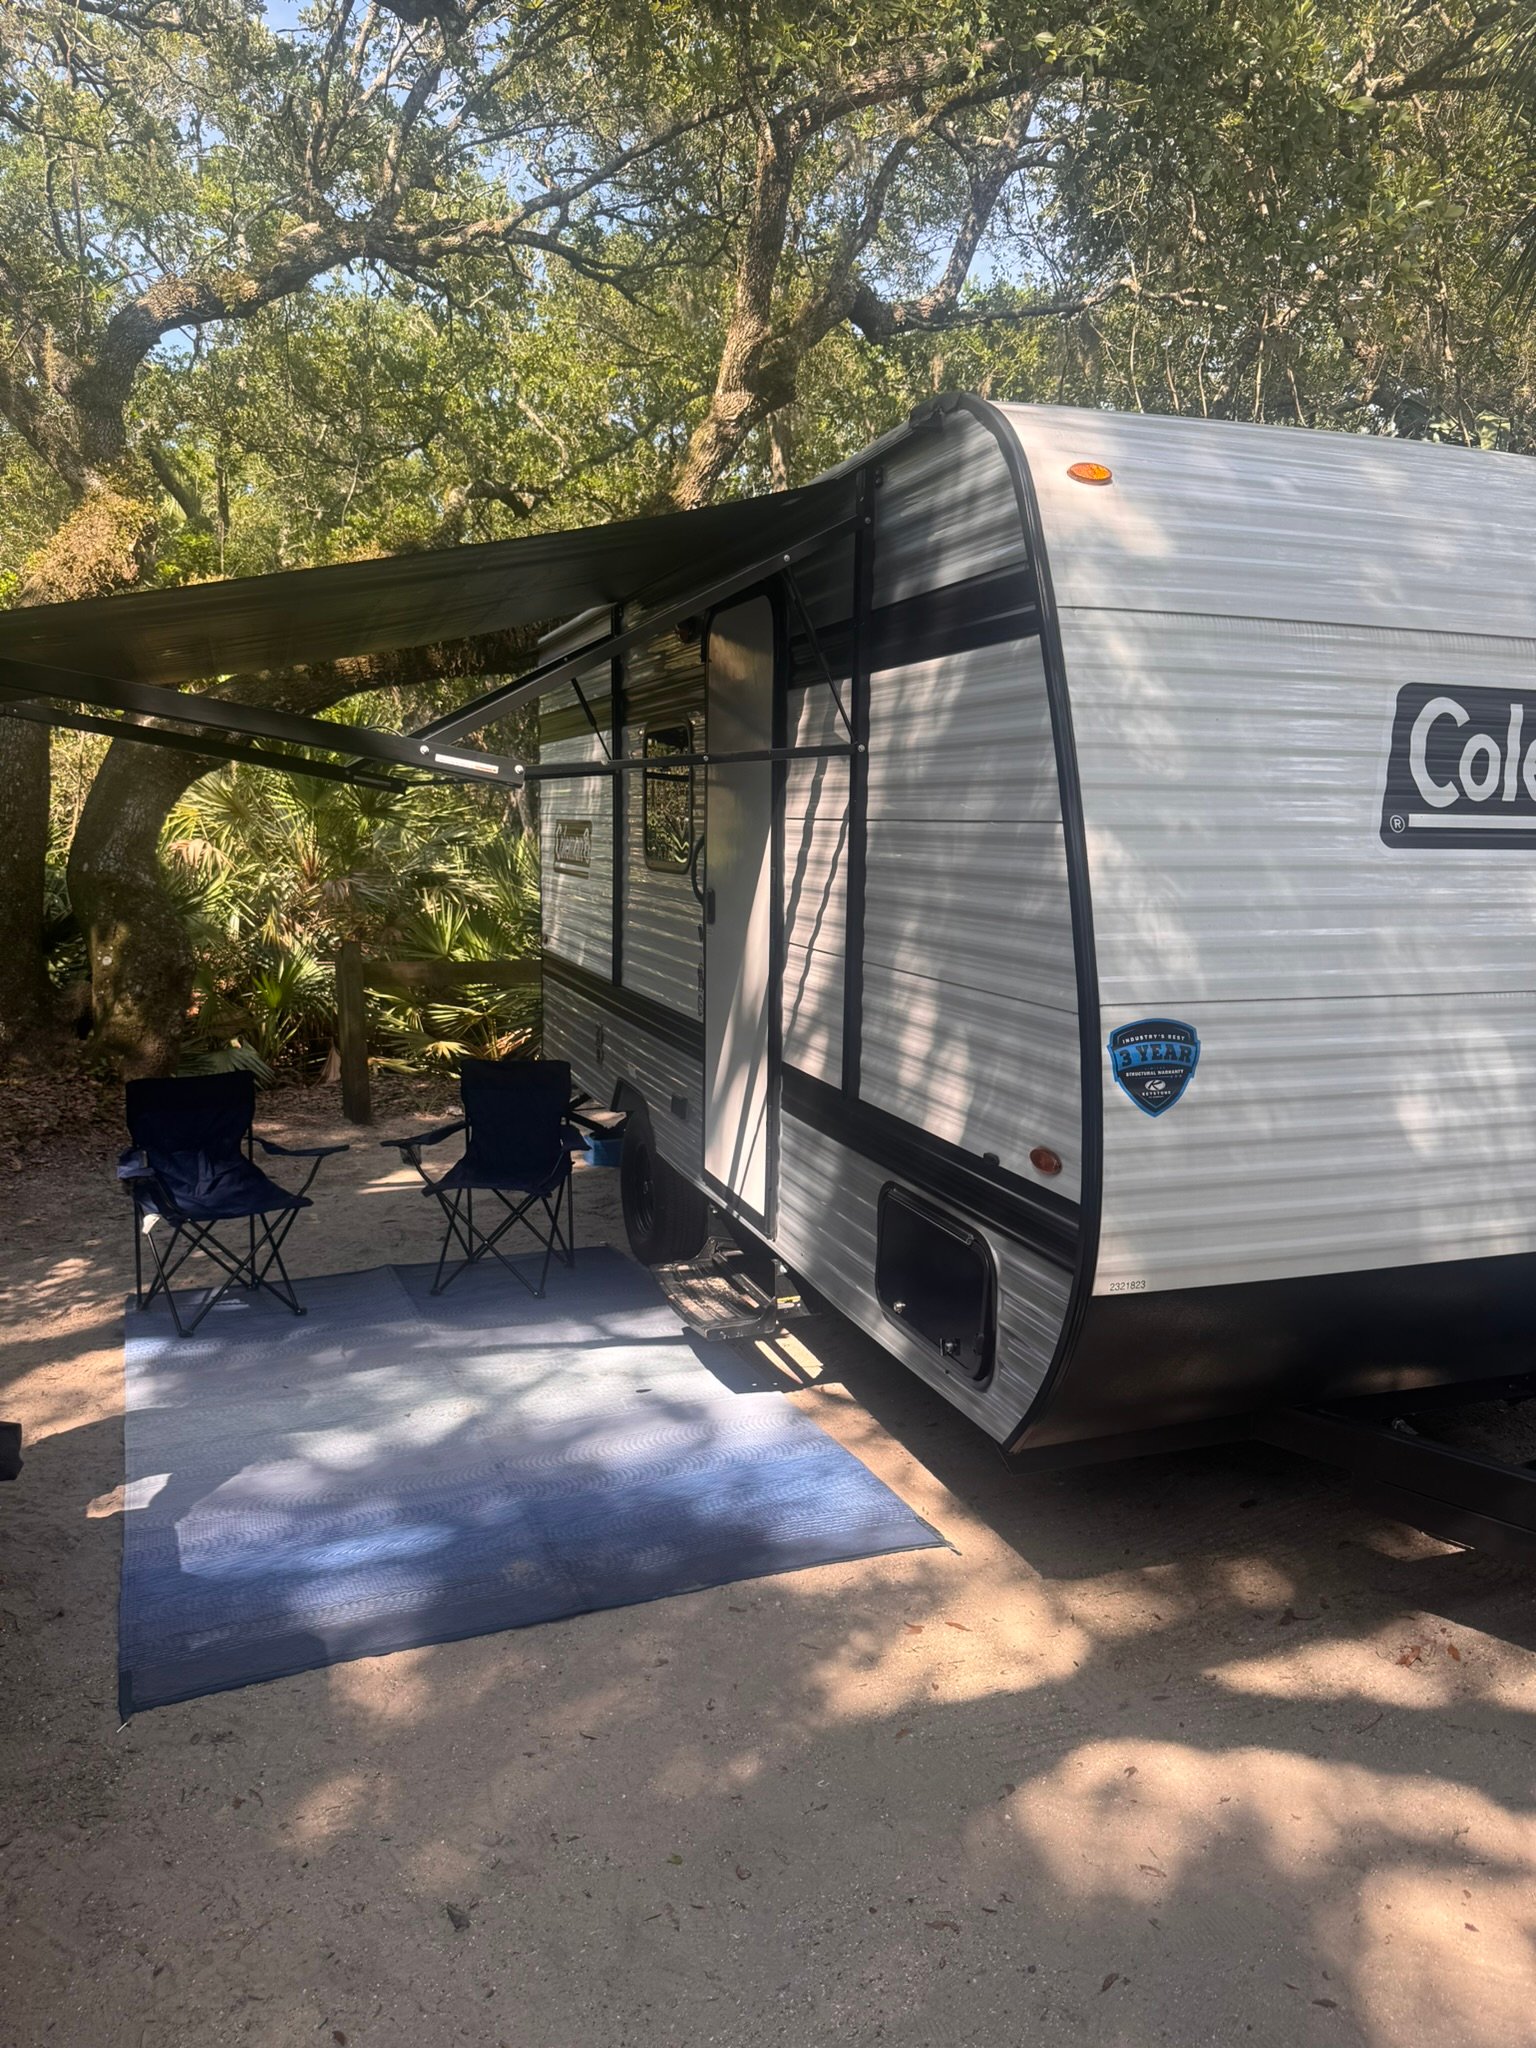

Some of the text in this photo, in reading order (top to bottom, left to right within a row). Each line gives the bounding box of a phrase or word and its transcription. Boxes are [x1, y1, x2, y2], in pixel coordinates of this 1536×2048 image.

[1122, 1034, 1165, 1044] INDUSTRY'S
[1119, 1044, 1192, 1067] 3 YEAR
[1110, 1280, 1146, 1291] 2321823
